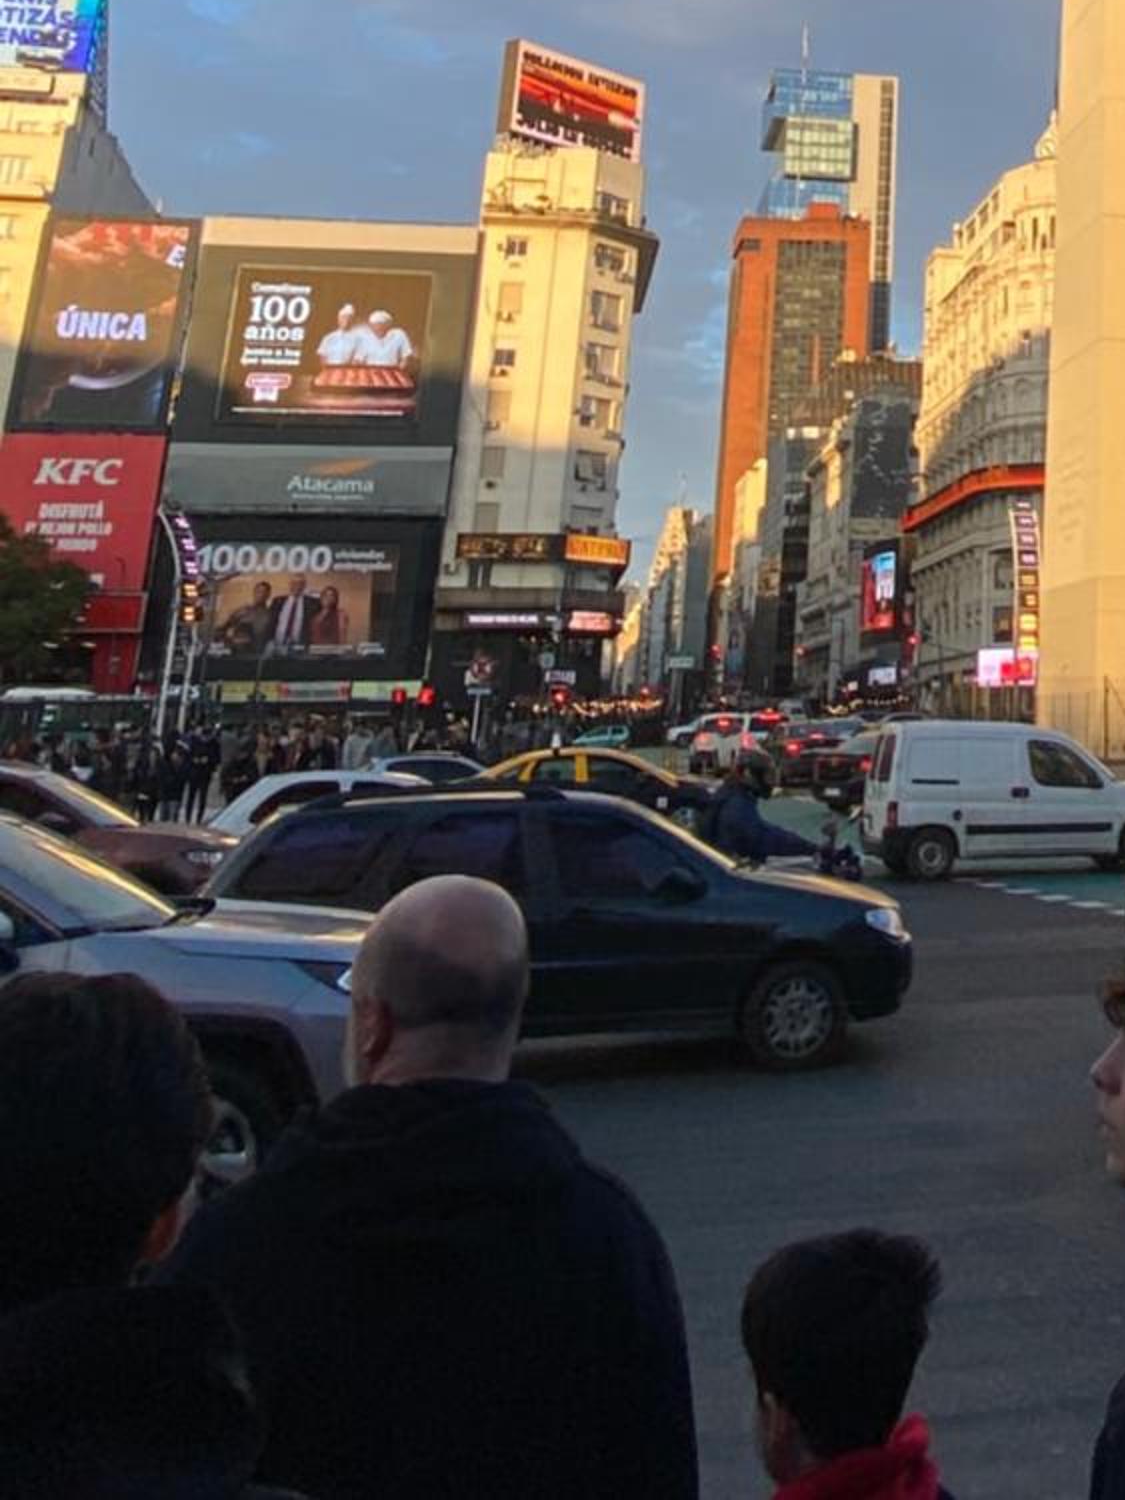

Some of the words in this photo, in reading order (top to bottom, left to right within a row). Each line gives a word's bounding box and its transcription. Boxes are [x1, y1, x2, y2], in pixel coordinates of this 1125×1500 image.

[57, 304, 147, 341] ÚNICA
[249, 296, 310, 324] 100
[244, 323, 305, 341] años
[33, 458, 123, 485] KFC
[287, 475, 374, 493] Atacama
[198, 546, 332, 573] 100.000
